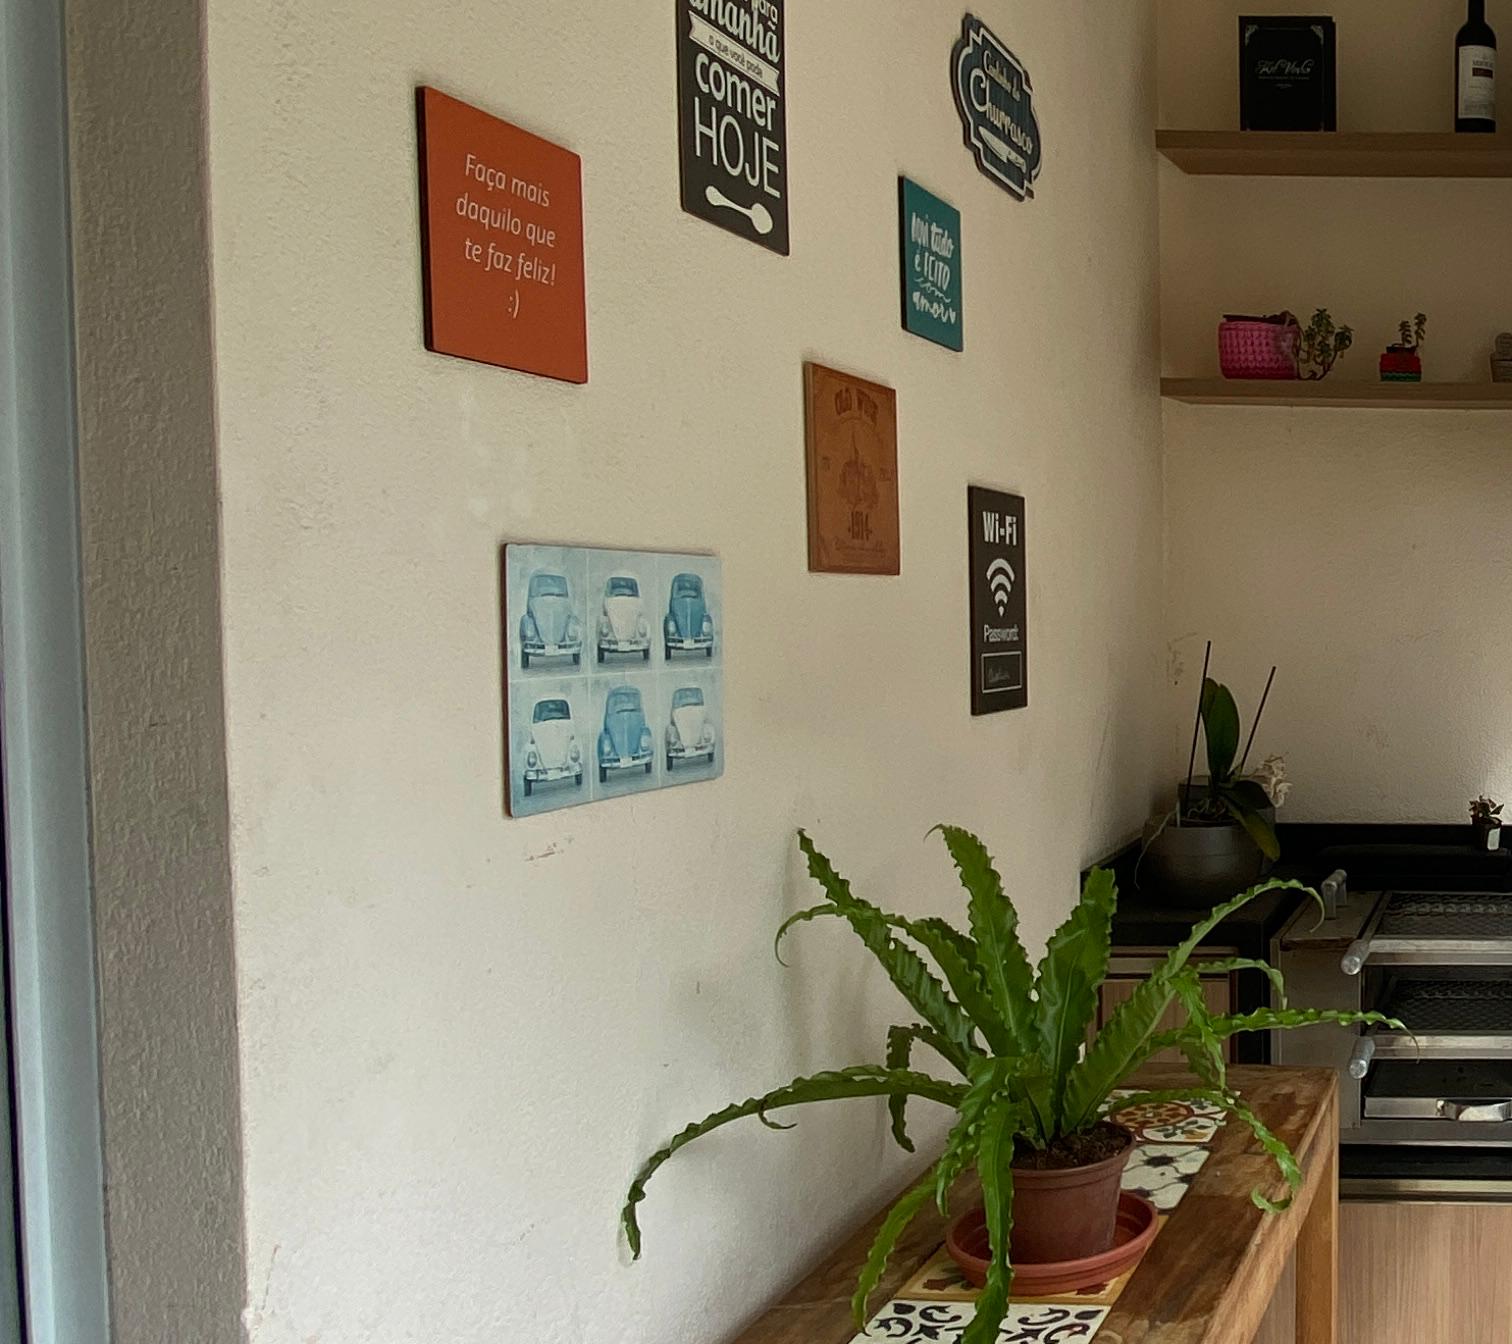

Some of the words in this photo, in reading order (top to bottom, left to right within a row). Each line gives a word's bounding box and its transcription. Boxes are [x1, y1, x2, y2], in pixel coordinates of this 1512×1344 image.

[696, 52, 777, 131] comer
[970, 67, 1033, 155] Churrasco
[695, 96, 781, 199] HOJE
[465, 153, 506, 192] Faça
[511, 176, 550, 208] mais
[456, 193, 521, 236] daquilo
[526, 221, 556, 248] que
[465, 237, 482, 263] te
[485, 242, 512, 273] faz
[516, 252, 556, 286] feliz!
[983, 511, 1017, 546] Wi-Fi
